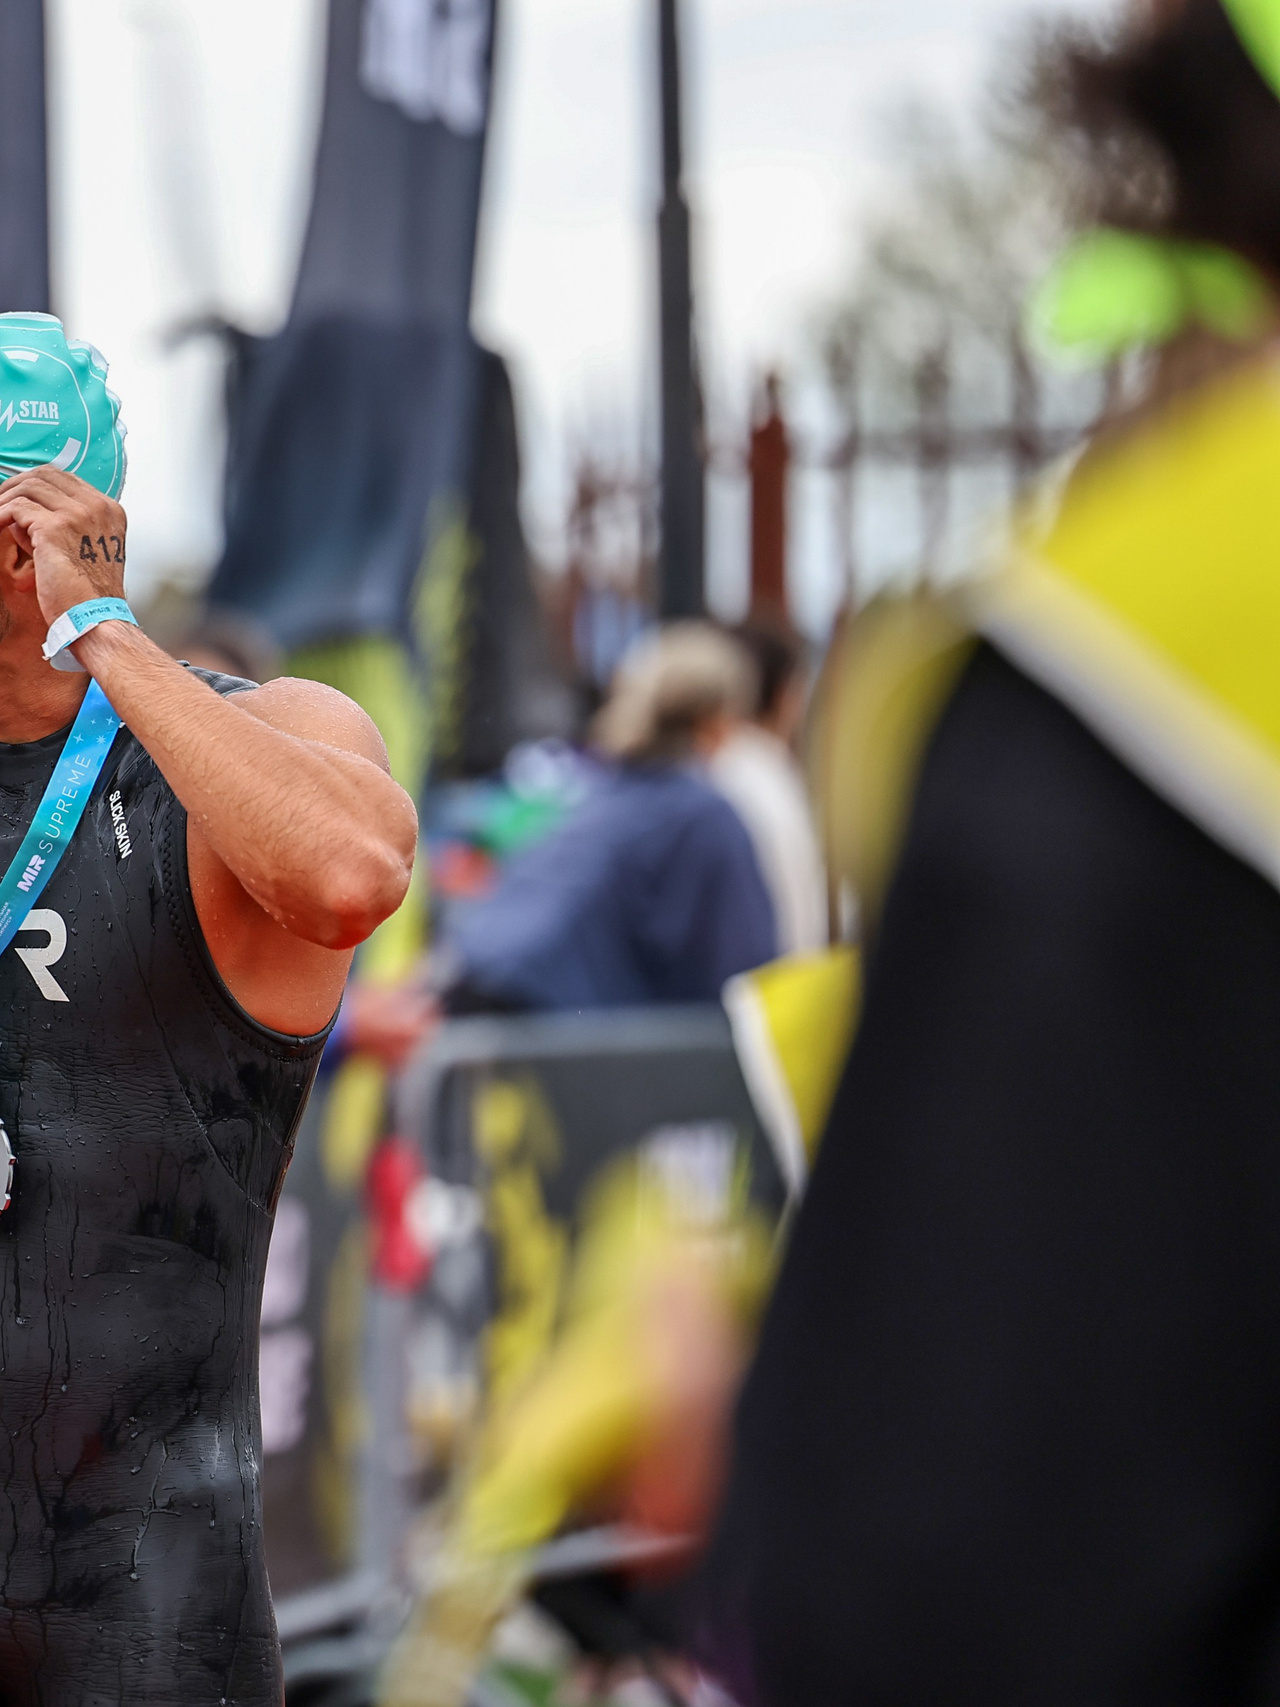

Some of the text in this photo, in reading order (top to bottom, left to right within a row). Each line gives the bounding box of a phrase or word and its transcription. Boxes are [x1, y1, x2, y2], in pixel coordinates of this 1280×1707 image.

[19, 400, 60, 420] STAR
[16, 754, 91, 893] MIR SUPREME
[109, 790, 133, 860] SLICK SKIN
